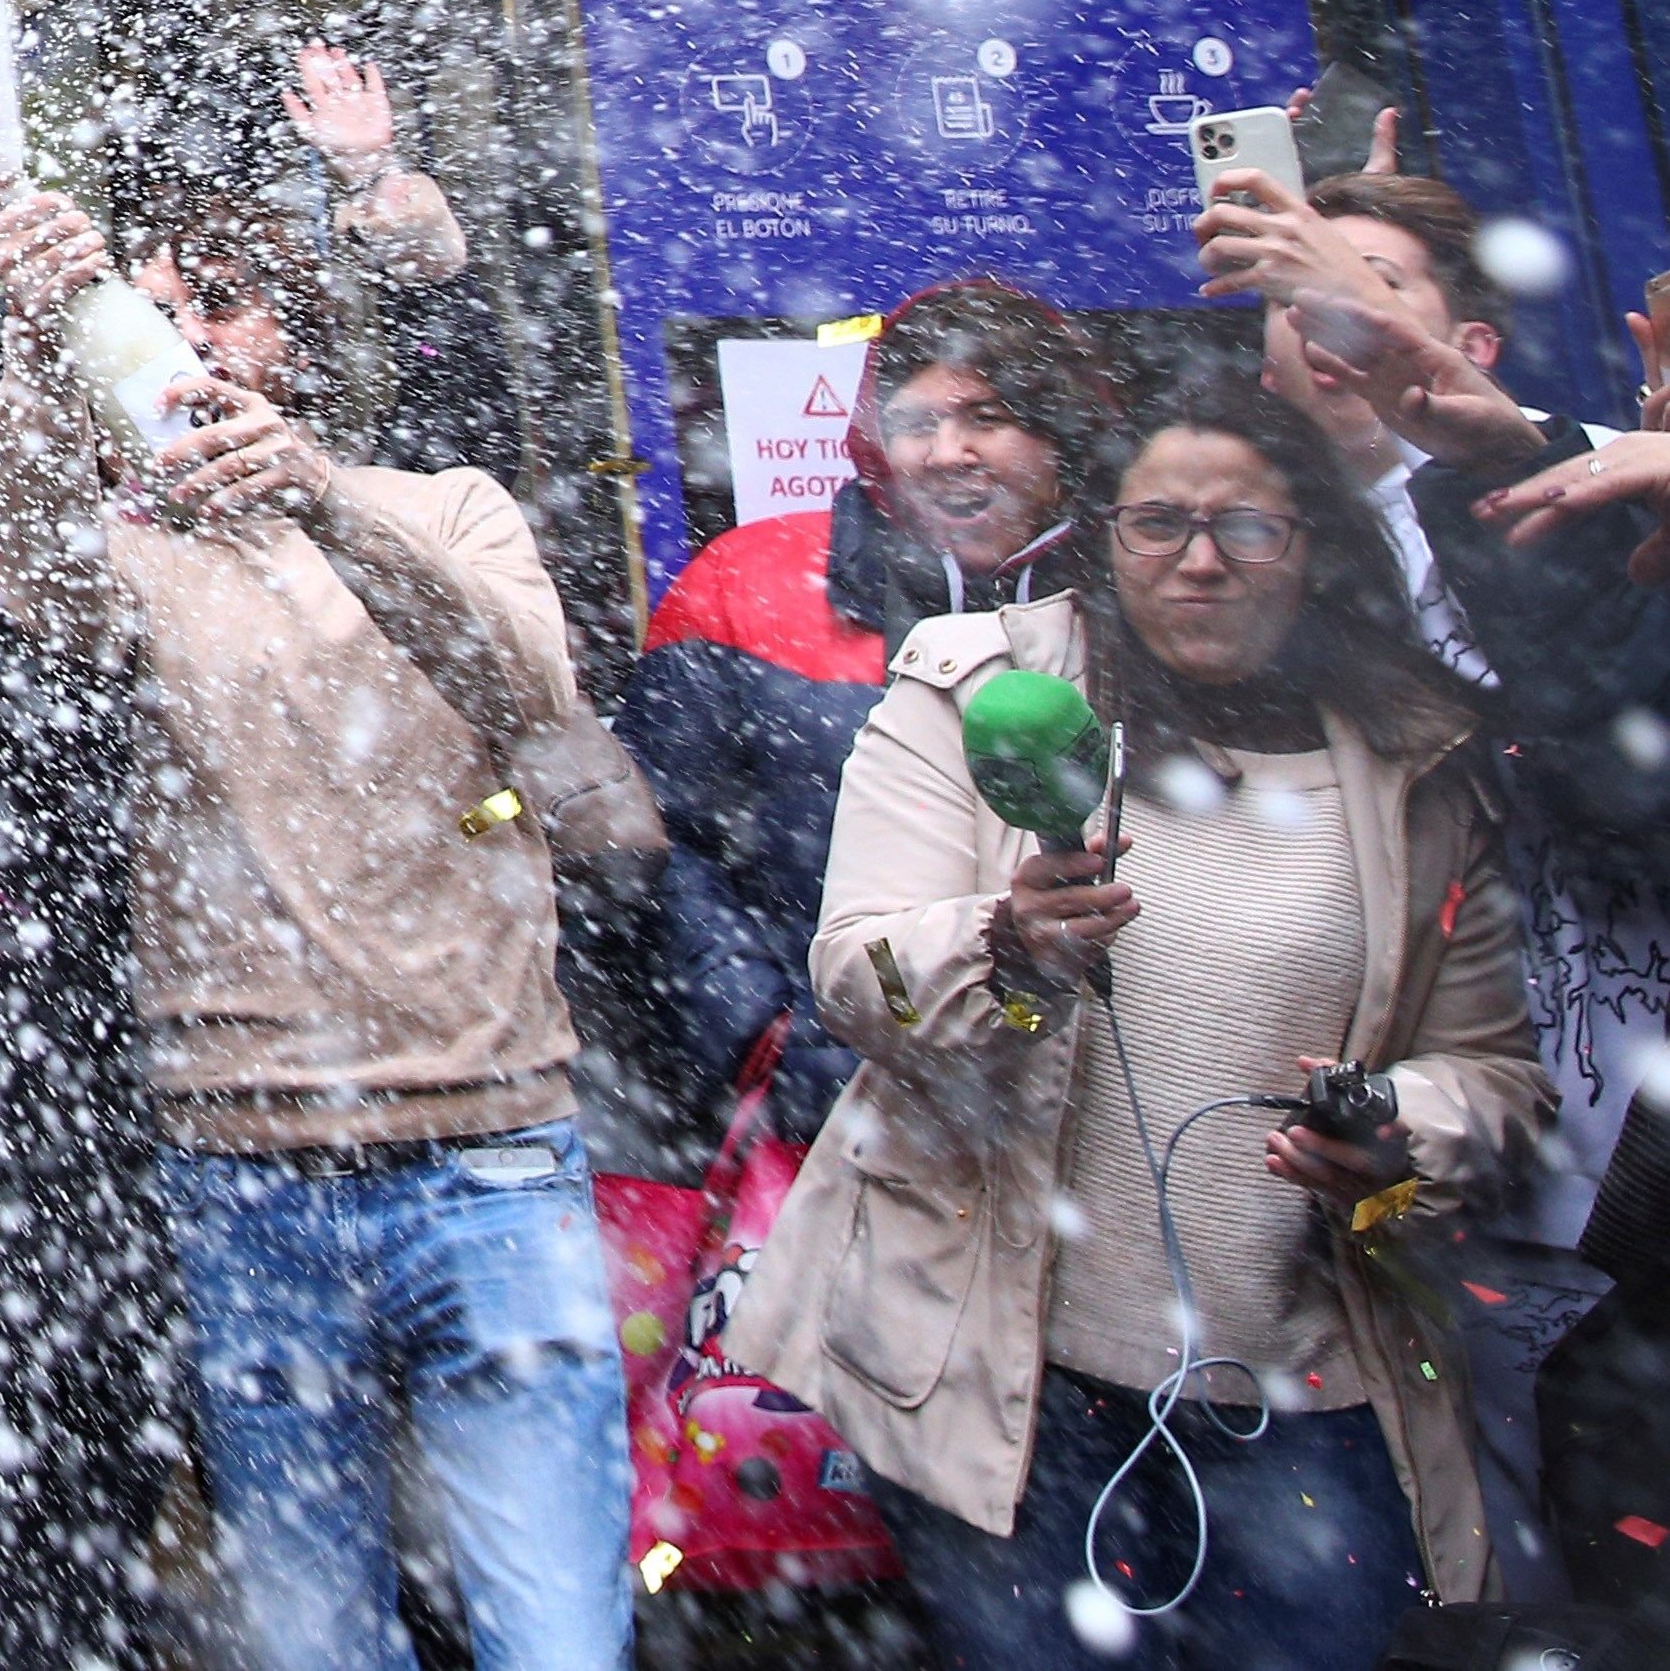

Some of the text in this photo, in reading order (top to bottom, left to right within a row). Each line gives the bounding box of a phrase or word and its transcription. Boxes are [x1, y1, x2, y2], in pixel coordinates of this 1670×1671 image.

[715, 218, 739, 240] EL
[931, 214, 957, 235] SU
[756, 438, 808, 460] HOY
[770, 475, 852, 498] AGOT
